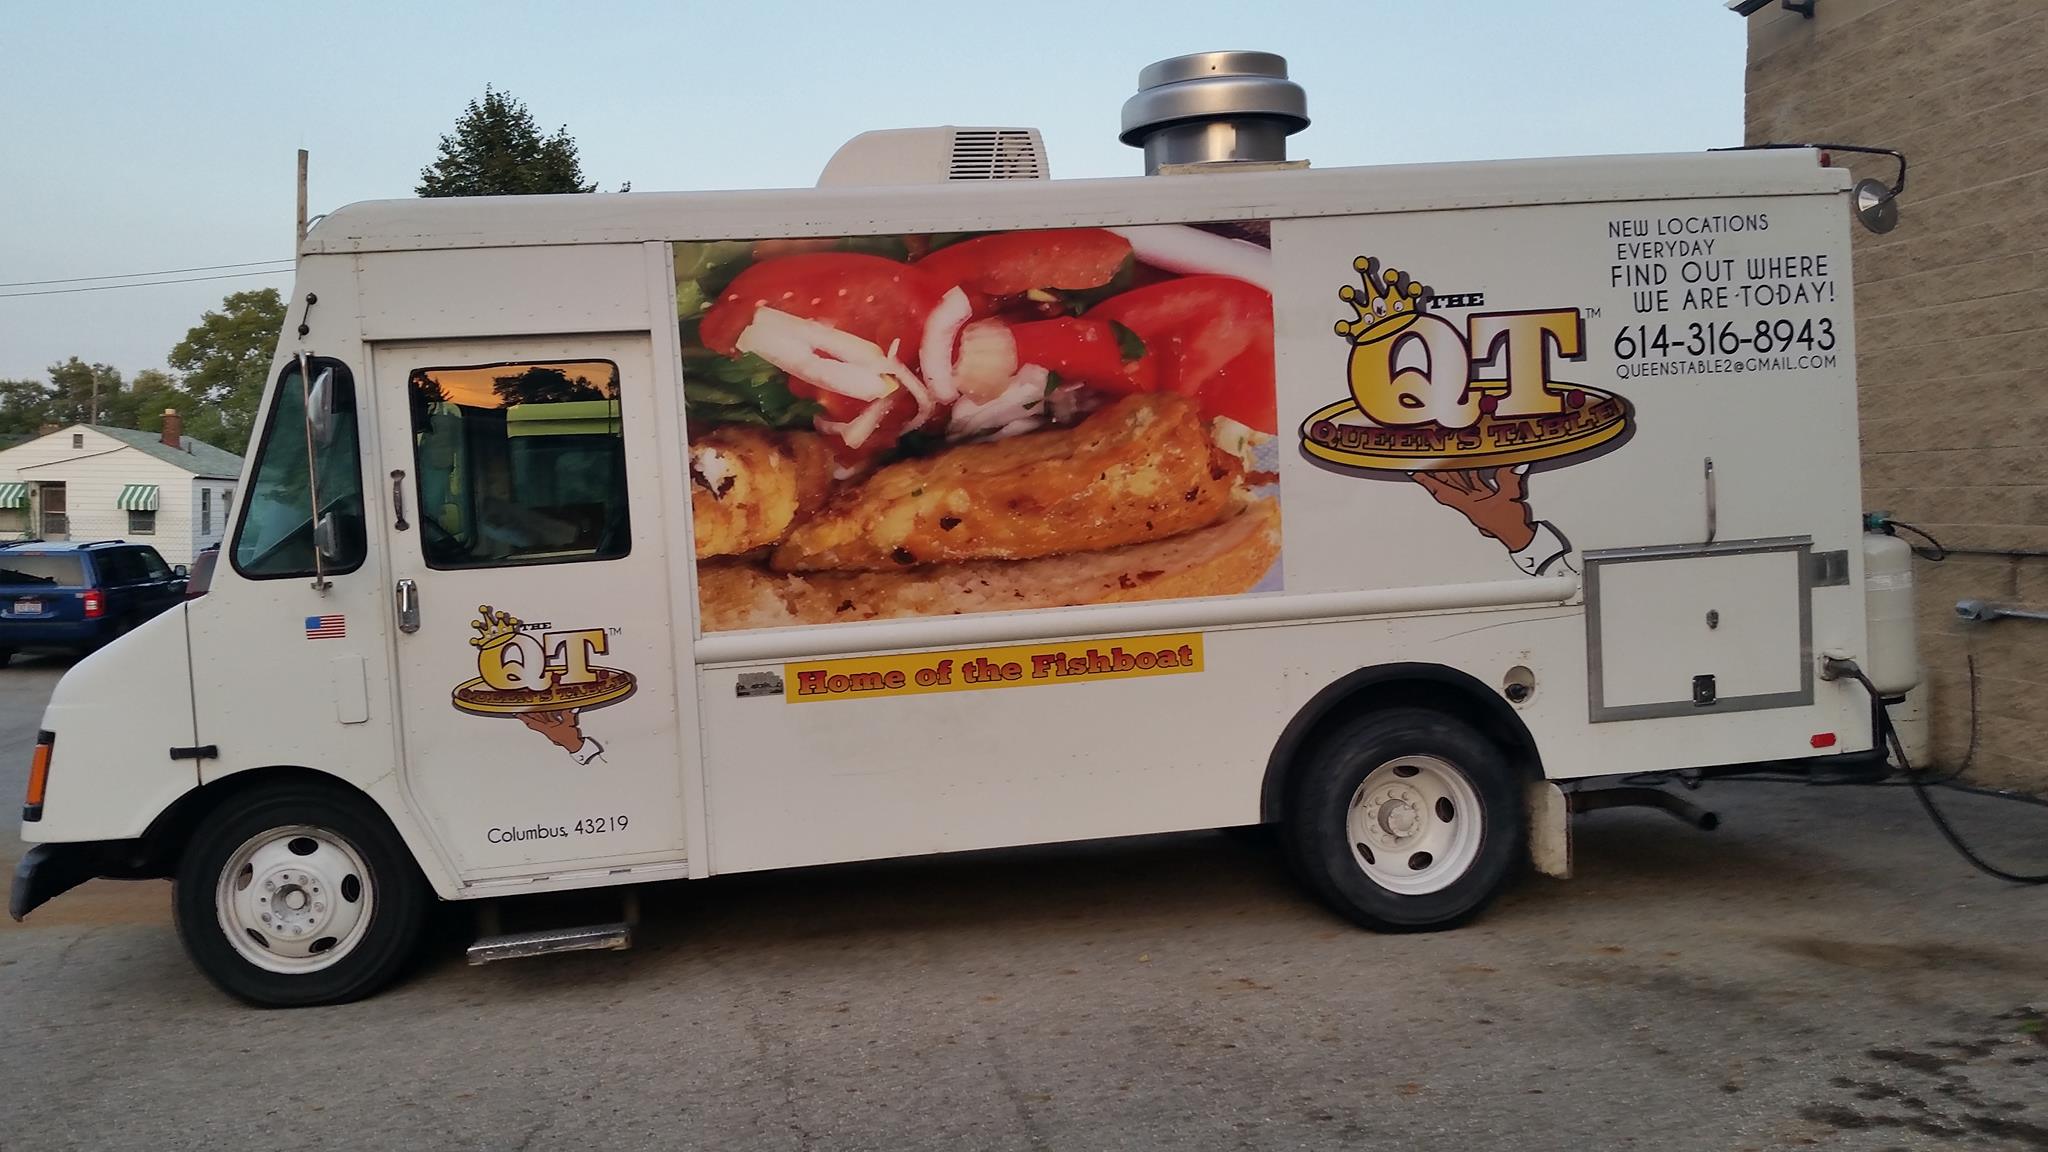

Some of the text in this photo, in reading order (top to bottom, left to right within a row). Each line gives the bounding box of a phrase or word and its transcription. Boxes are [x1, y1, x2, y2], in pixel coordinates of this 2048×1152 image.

[1608, 213, 1769, 238] NEW LOCATIONS
[1617, 239, 1716, 260] EVERYDAY
[1611, 255, 1829, 287] FIND OUT WHERE
[1429, 293, 1485, 309] THE
[1634, 281, 1835, 313] WE ARE TODAY!
[1613, 317, 1836, 360] 614-316-8943
[1616, 355, 1837, 380] QUEENSTABLE2@GMAIL.COM
[1310, 398, 1620, 451] QUEEN'S TABLE
[521, 622, 552, 632] THE
[798, 644, 1193, 695] Home of the Fishboat
[487, 815, 629, 843] Columbus, 43219
